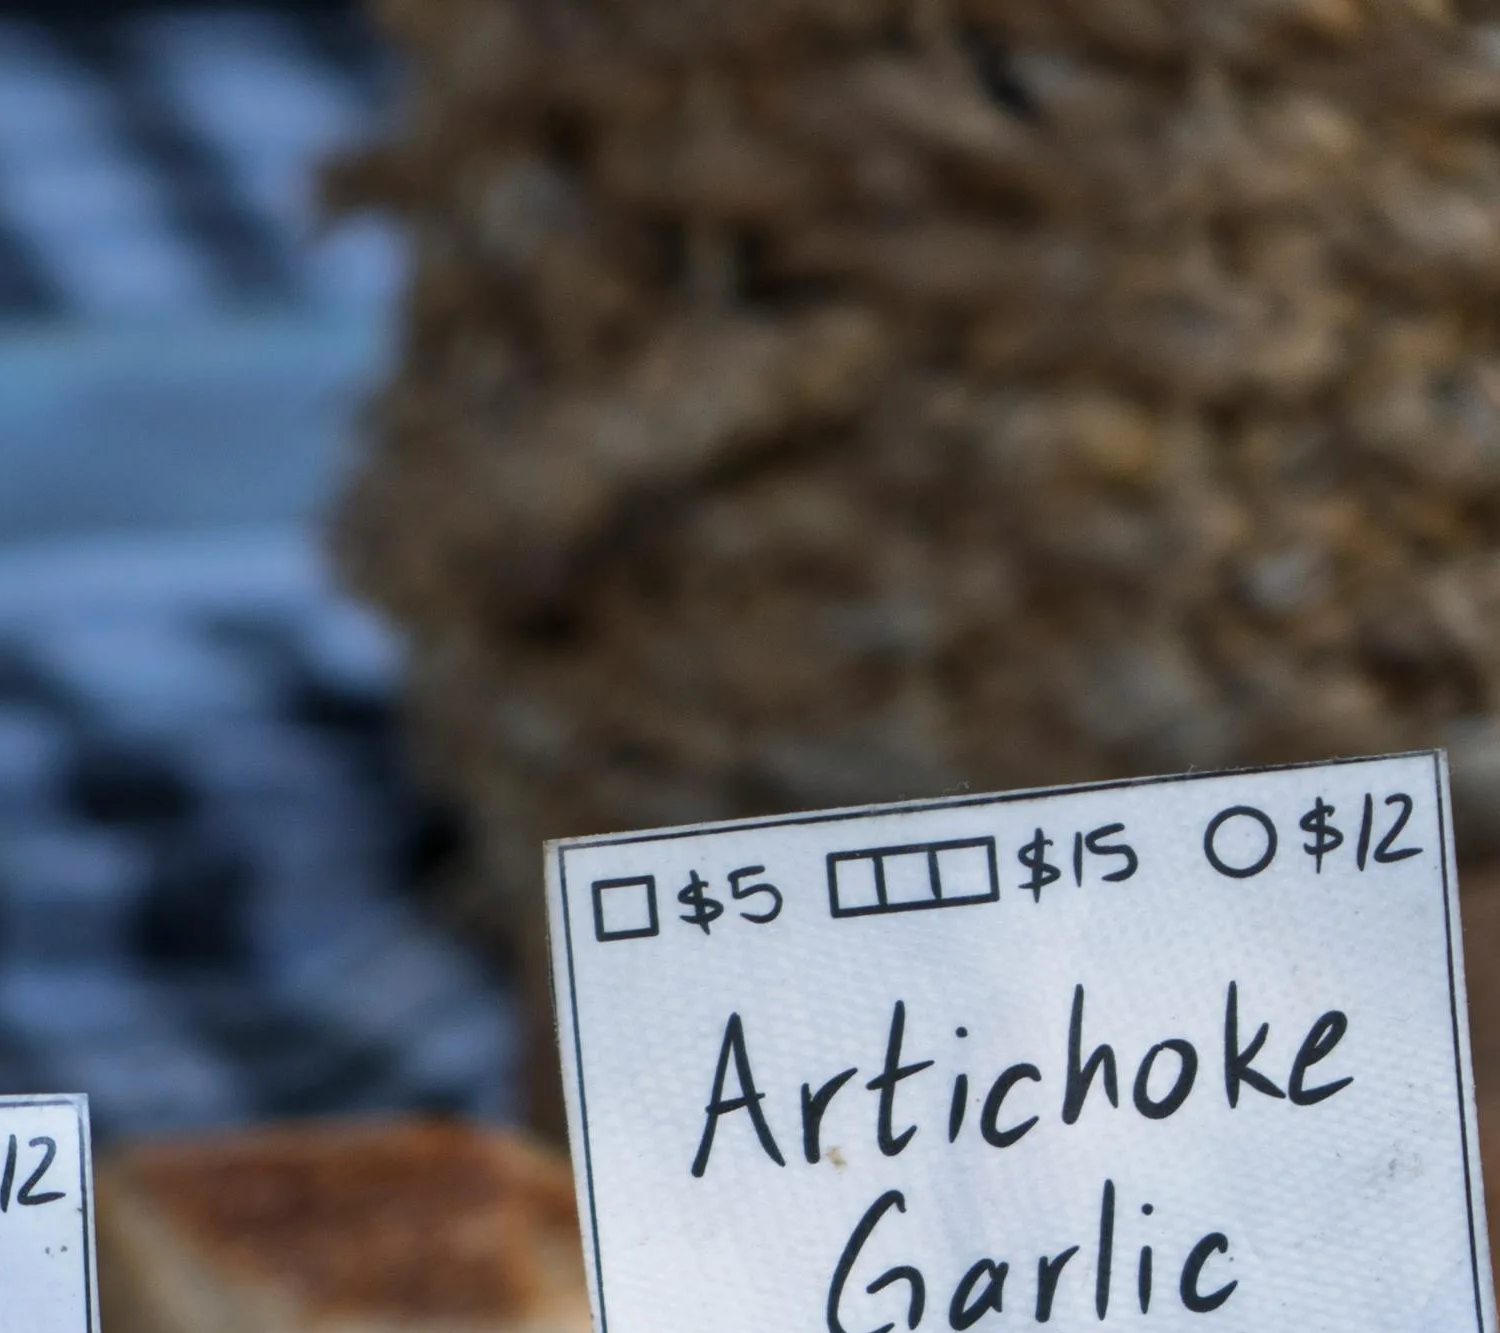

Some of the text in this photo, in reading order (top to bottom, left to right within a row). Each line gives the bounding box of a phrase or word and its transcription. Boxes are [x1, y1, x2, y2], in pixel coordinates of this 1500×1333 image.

[676, 792, 1424, 934] $5 $15 $12
[691, 980, 1355, 1178] Artichoke
